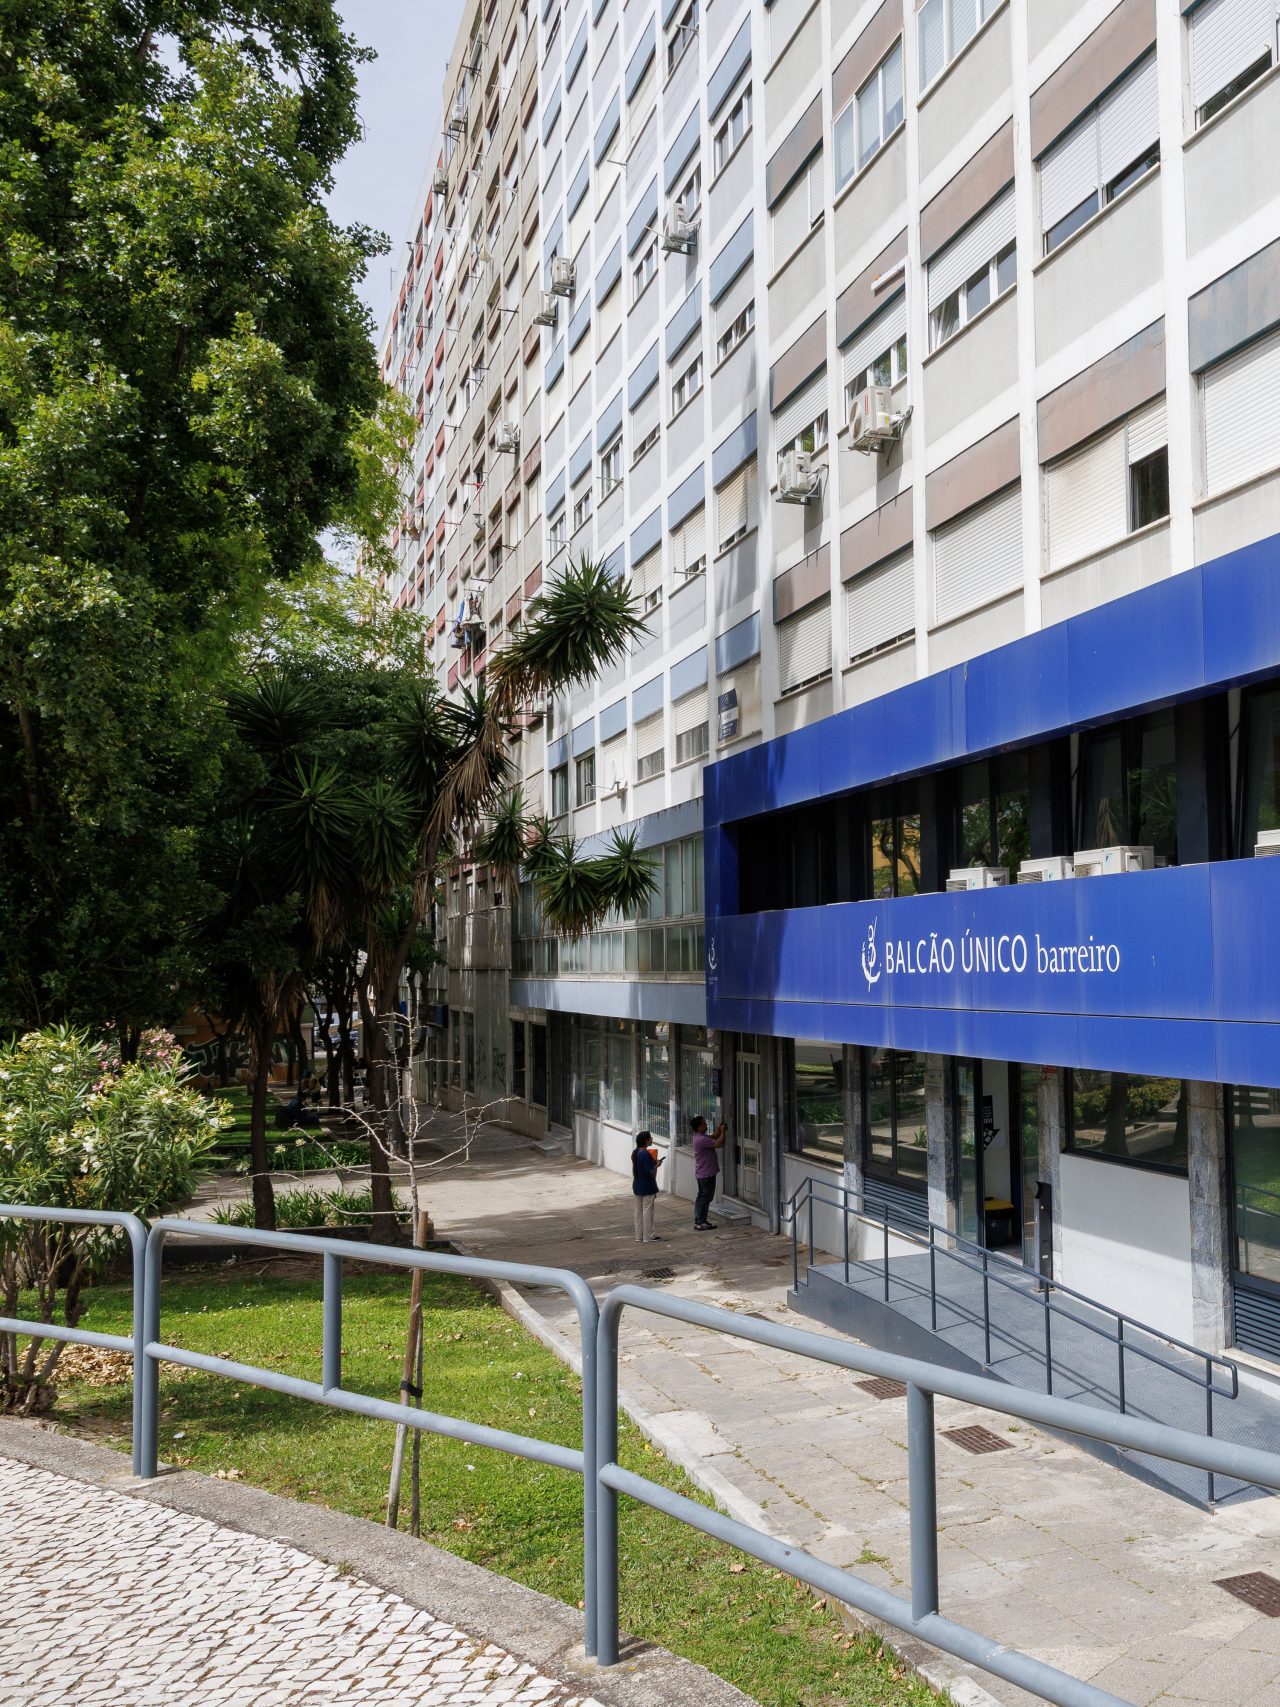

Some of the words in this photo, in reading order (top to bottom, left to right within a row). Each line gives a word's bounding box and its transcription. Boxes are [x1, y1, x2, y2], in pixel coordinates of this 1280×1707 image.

[885, 932, 955, 974] BALCÃO
[962, 929, 1028, 973] ÚNICO
[1034, 933, 1122, 974] barreiro
